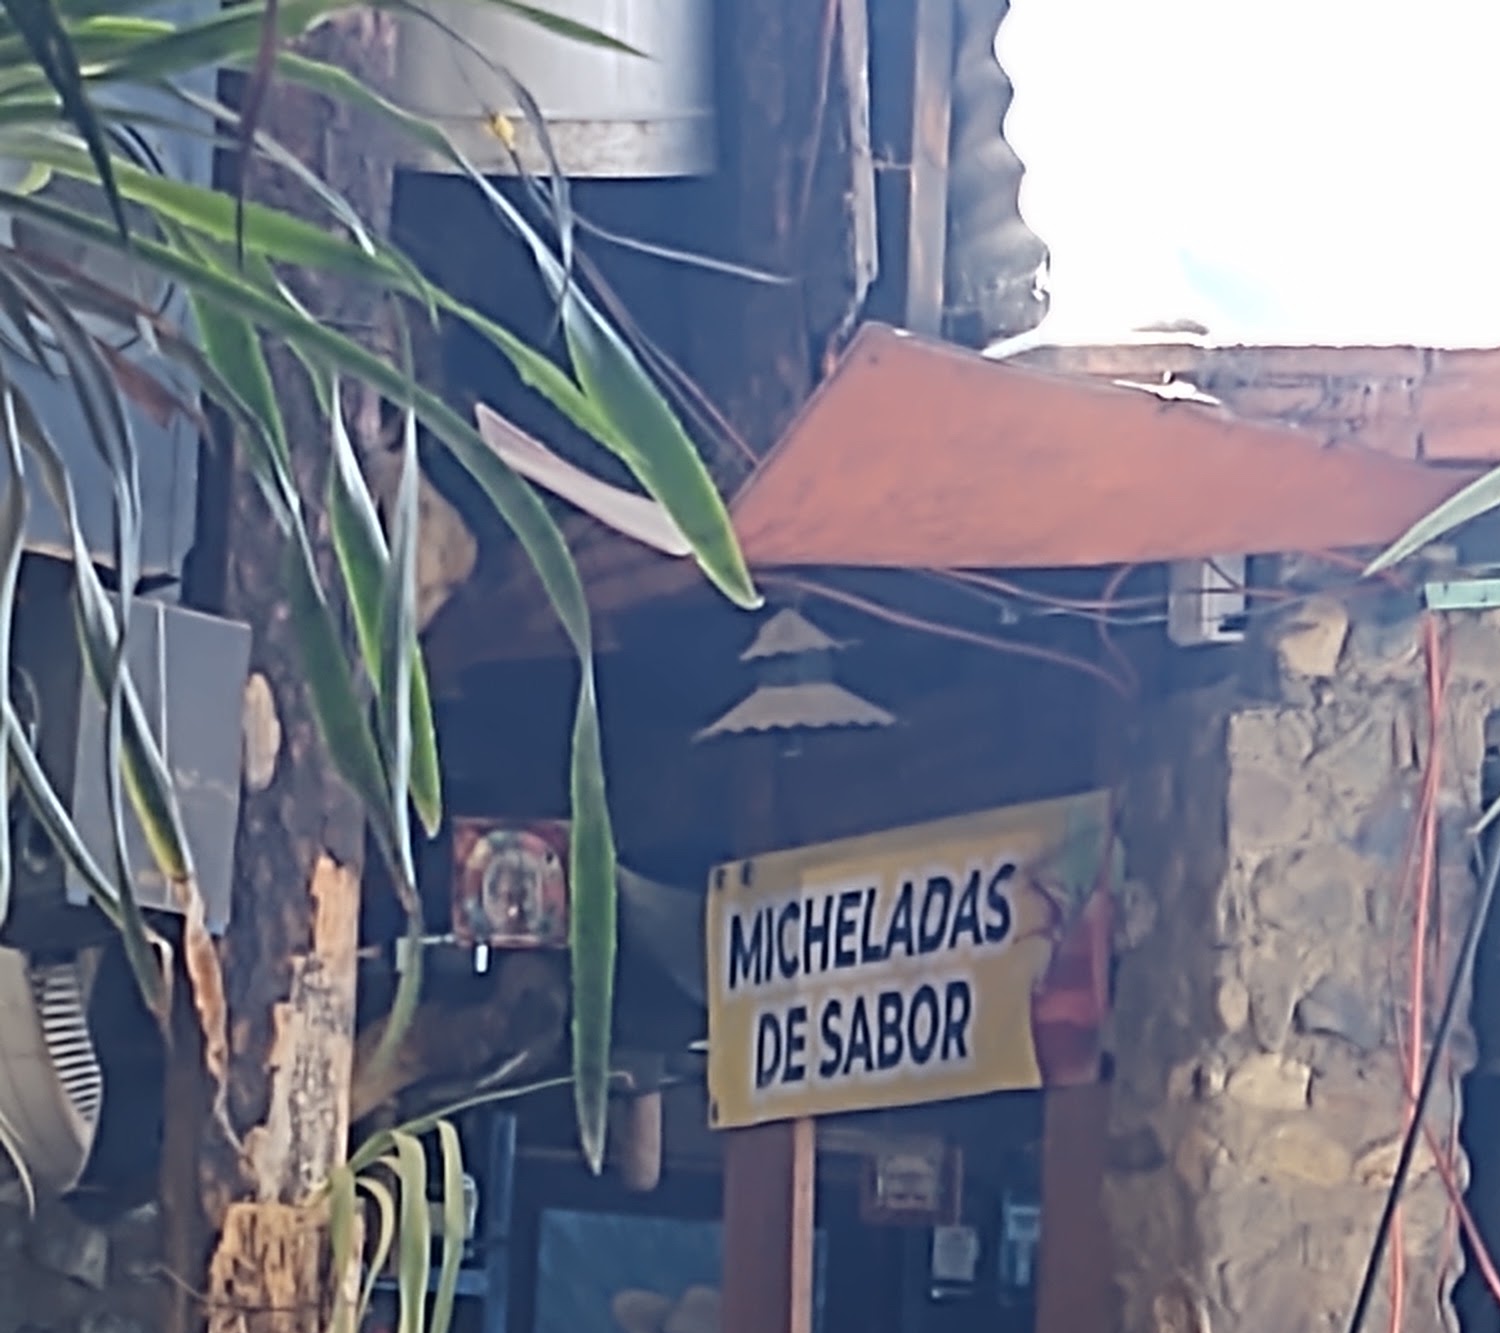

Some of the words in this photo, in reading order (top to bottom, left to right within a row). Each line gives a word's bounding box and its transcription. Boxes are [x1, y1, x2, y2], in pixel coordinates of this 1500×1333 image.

[728, 862, 1017, 990] MICHELADAS
[755, 1004, 808, 1090] DE
[819, 980, 972, 1079] SABOR
